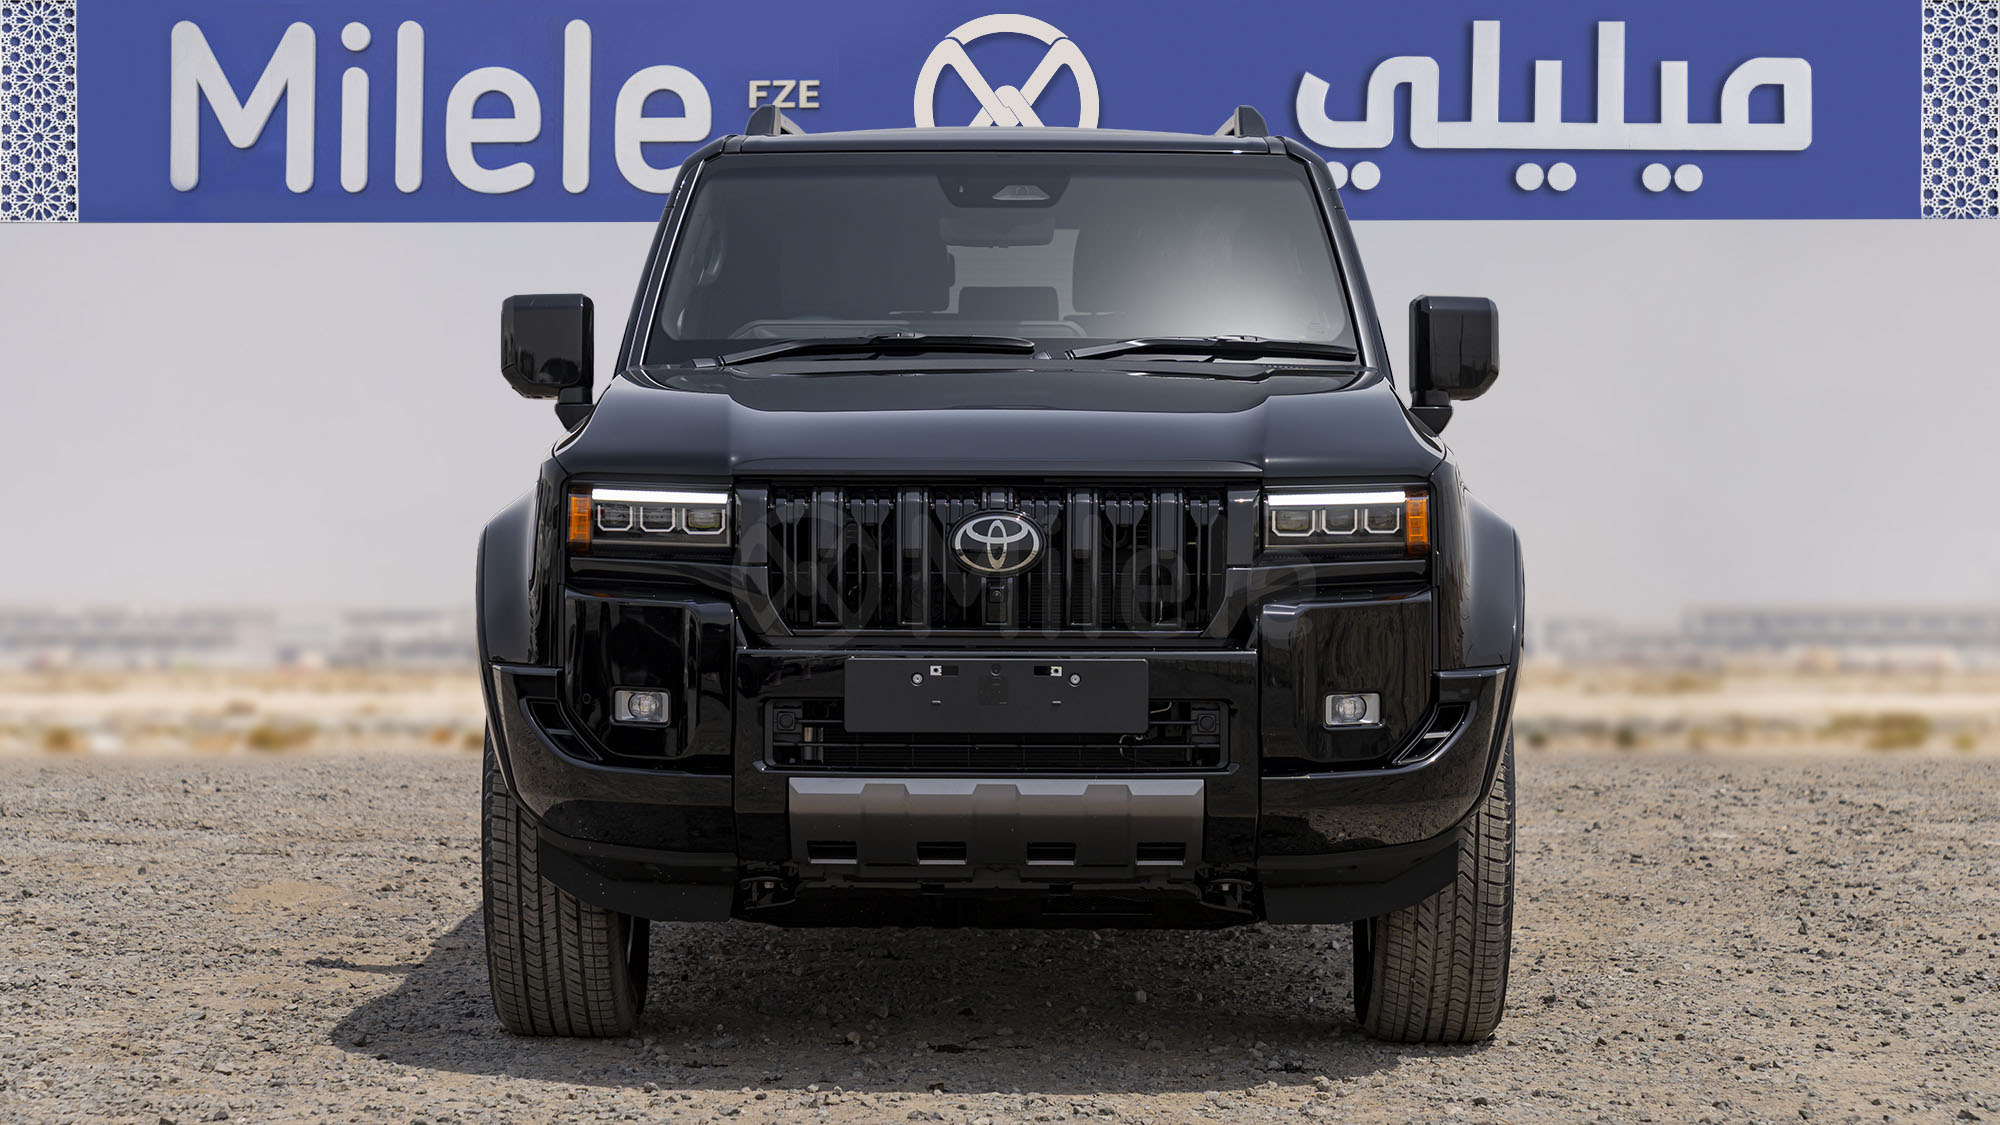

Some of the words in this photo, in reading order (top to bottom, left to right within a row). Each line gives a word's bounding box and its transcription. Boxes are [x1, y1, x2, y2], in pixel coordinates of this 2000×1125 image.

[170, 19, 712, 194] Milele
[748, 79, 820, 109] FZE
[1296, 20, 1812, 192] ميليلي
